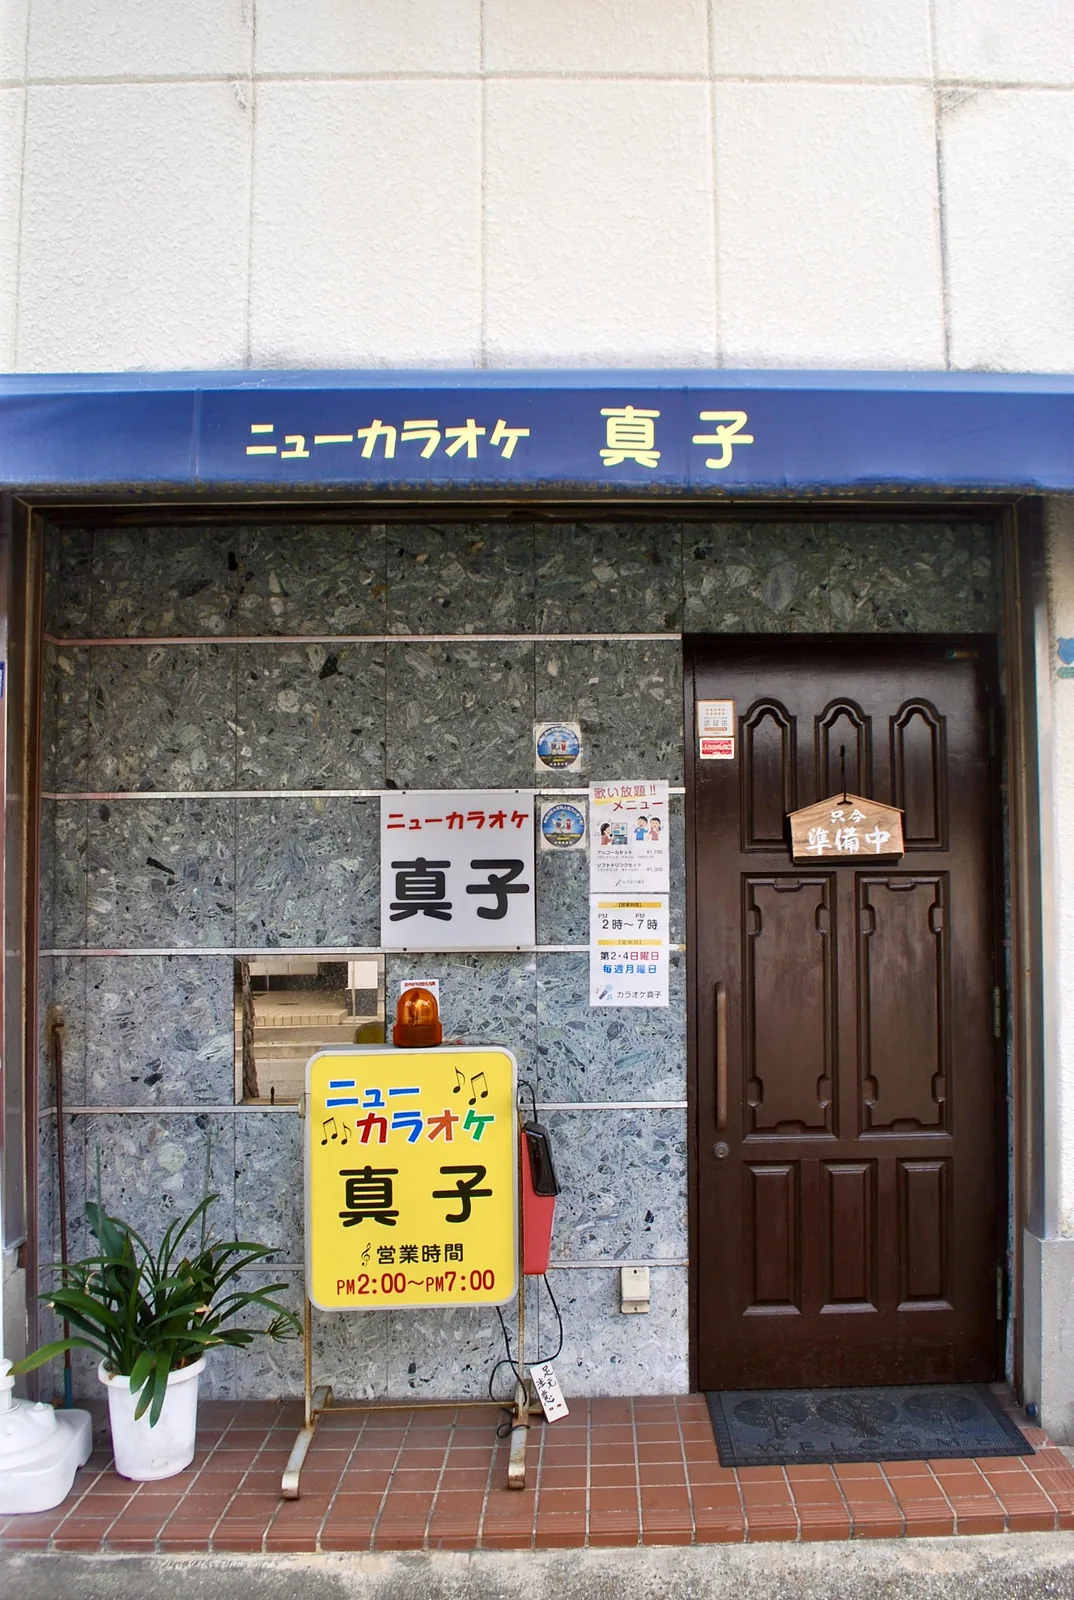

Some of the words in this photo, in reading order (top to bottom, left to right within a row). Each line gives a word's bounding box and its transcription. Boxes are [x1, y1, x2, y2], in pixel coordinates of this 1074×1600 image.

[246, 418, 530, 459] ニューカラオケ
[600, 405, 753, 469] 真子
[613, 800, 664, 812] メニュー
[830, 808, 866, 824] 只今
[387, 810, 529, 830] ニューカラオケ
[805, 825, 891, 856] 準備中
[389, 857, 530, 922] 真子
[603, 964, 657, 974] 毎週月曜日
[617, 991, 662, 999] カラオケ真子
[326, 1080, 420, 1108] ニュー
[356, 1109, 495, 1144] カラオケ
[339, 1165, 493, 1228] 真子
[376, 1243, 464, 1264] 営業時間
